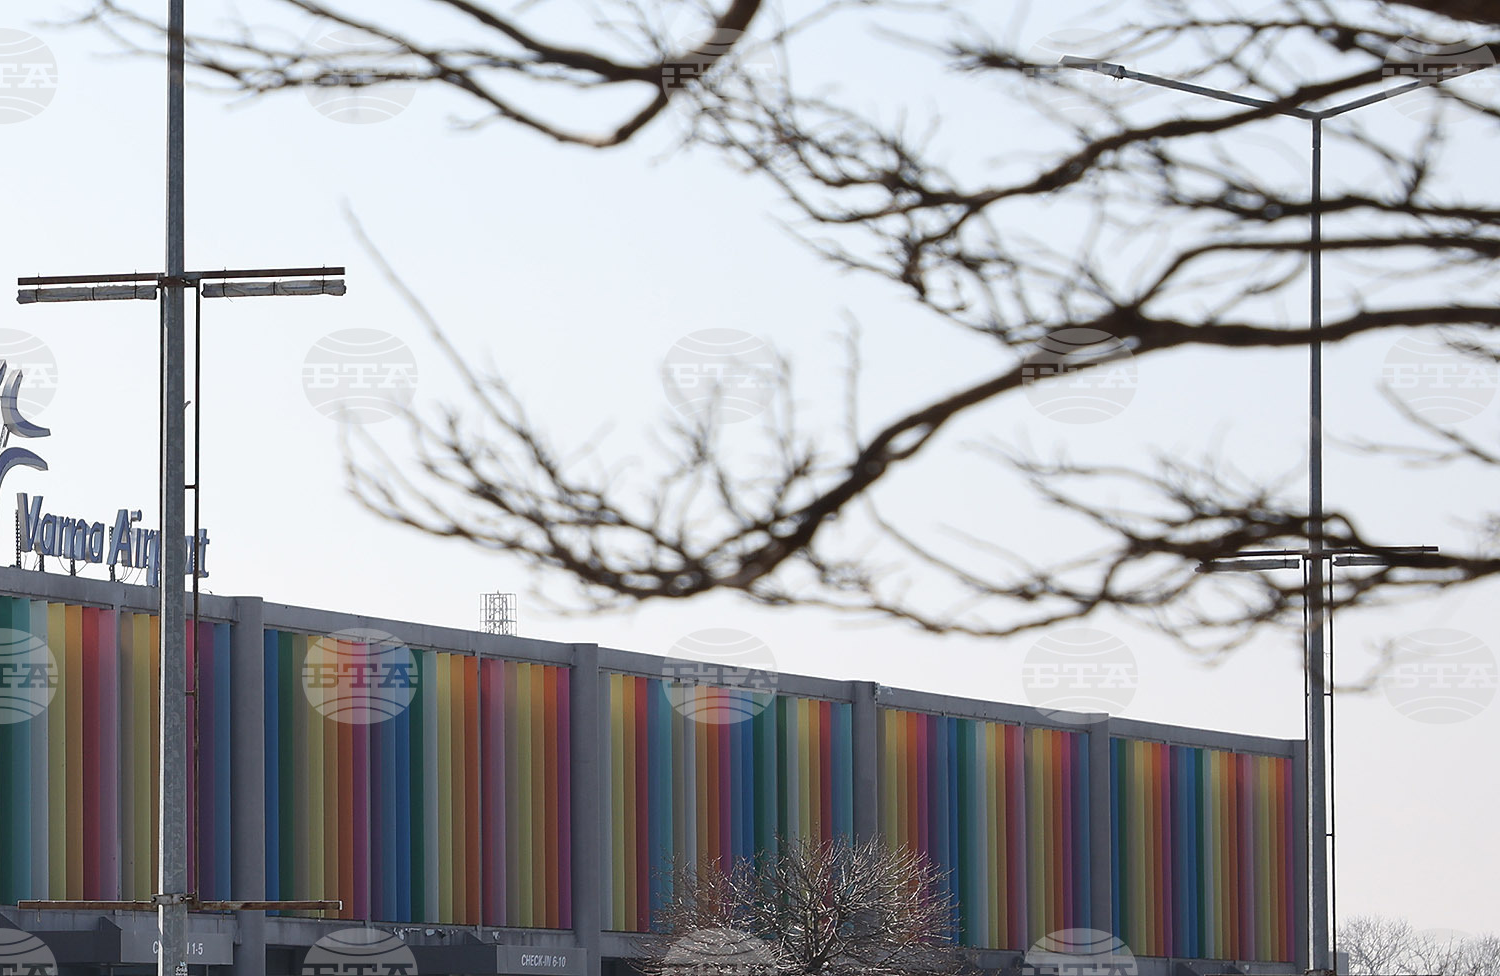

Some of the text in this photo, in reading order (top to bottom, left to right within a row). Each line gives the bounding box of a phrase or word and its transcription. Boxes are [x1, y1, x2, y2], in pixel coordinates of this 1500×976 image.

[17, 493, 105, 564] Varna
[521, 954, 567, 968] CHECK-IN 6-10
